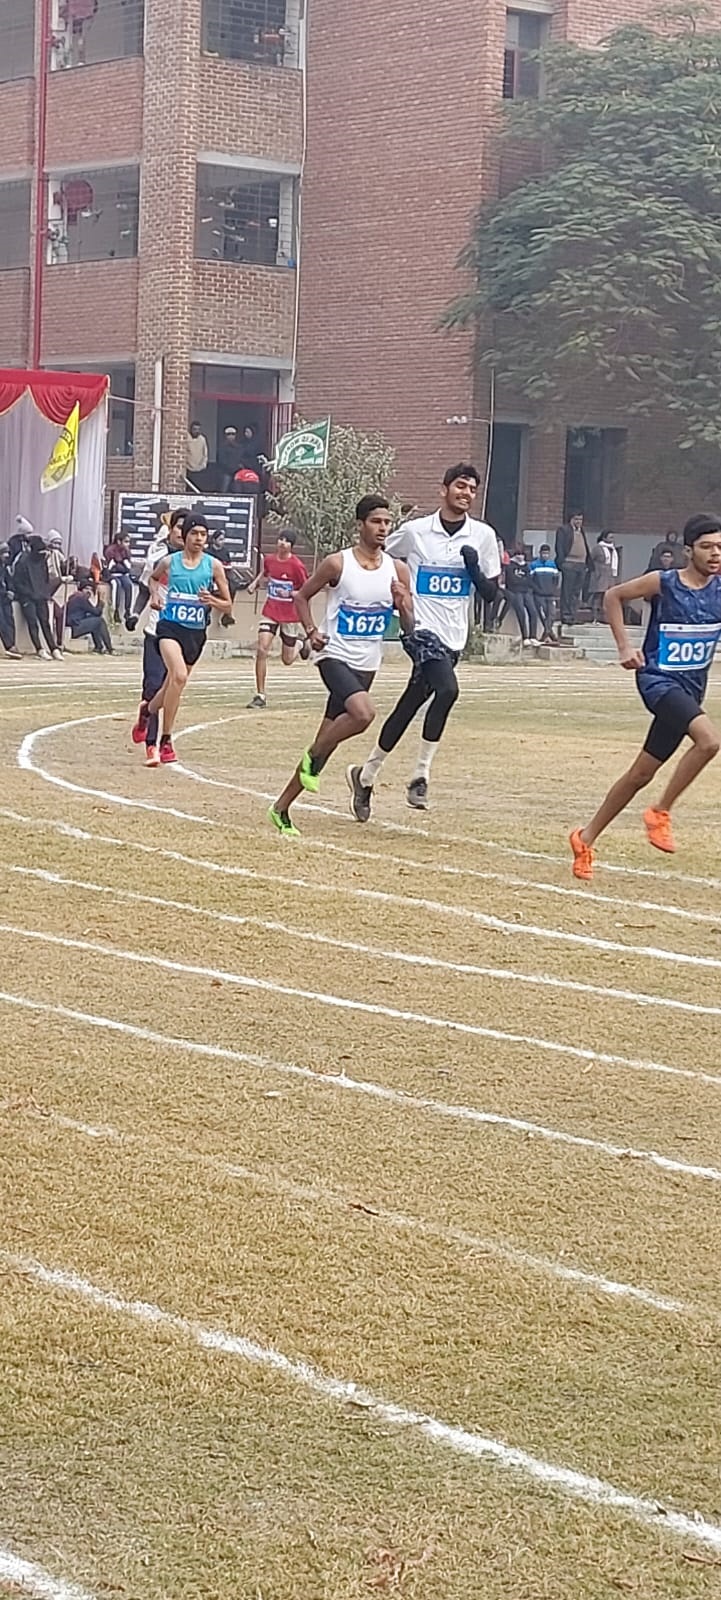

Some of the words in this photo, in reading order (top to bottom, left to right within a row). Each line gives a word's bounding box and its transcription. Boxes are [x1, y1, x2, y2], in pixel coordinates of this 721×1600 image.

[429, 575, 461, 593] 803
[171, 604, 204, 622] 1620
[346, 615, 385, 633] 1673
[667, 641, 715, 662] 2037
